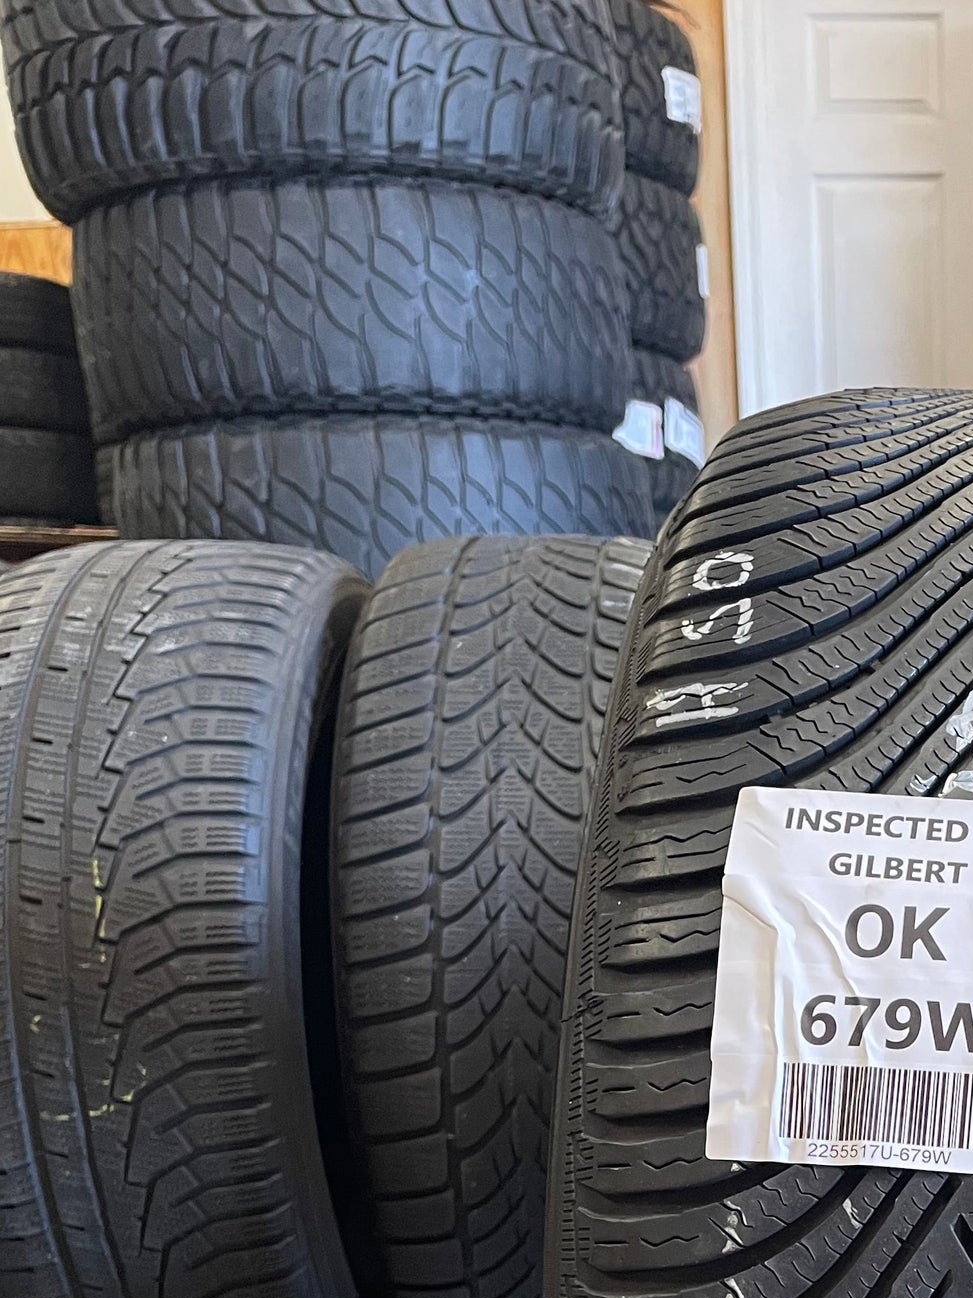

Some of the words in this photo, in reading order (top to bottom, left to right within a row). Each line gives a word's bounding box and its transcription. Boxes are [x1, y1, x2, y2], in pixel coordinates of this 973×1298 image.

[784, 807, 969, 843] INSPECTED
[828, 852, 969, 884] GILBERT
[844, 903, 951, 962] OK
[808, 1142, 953, 1166] 2255517U-679W
